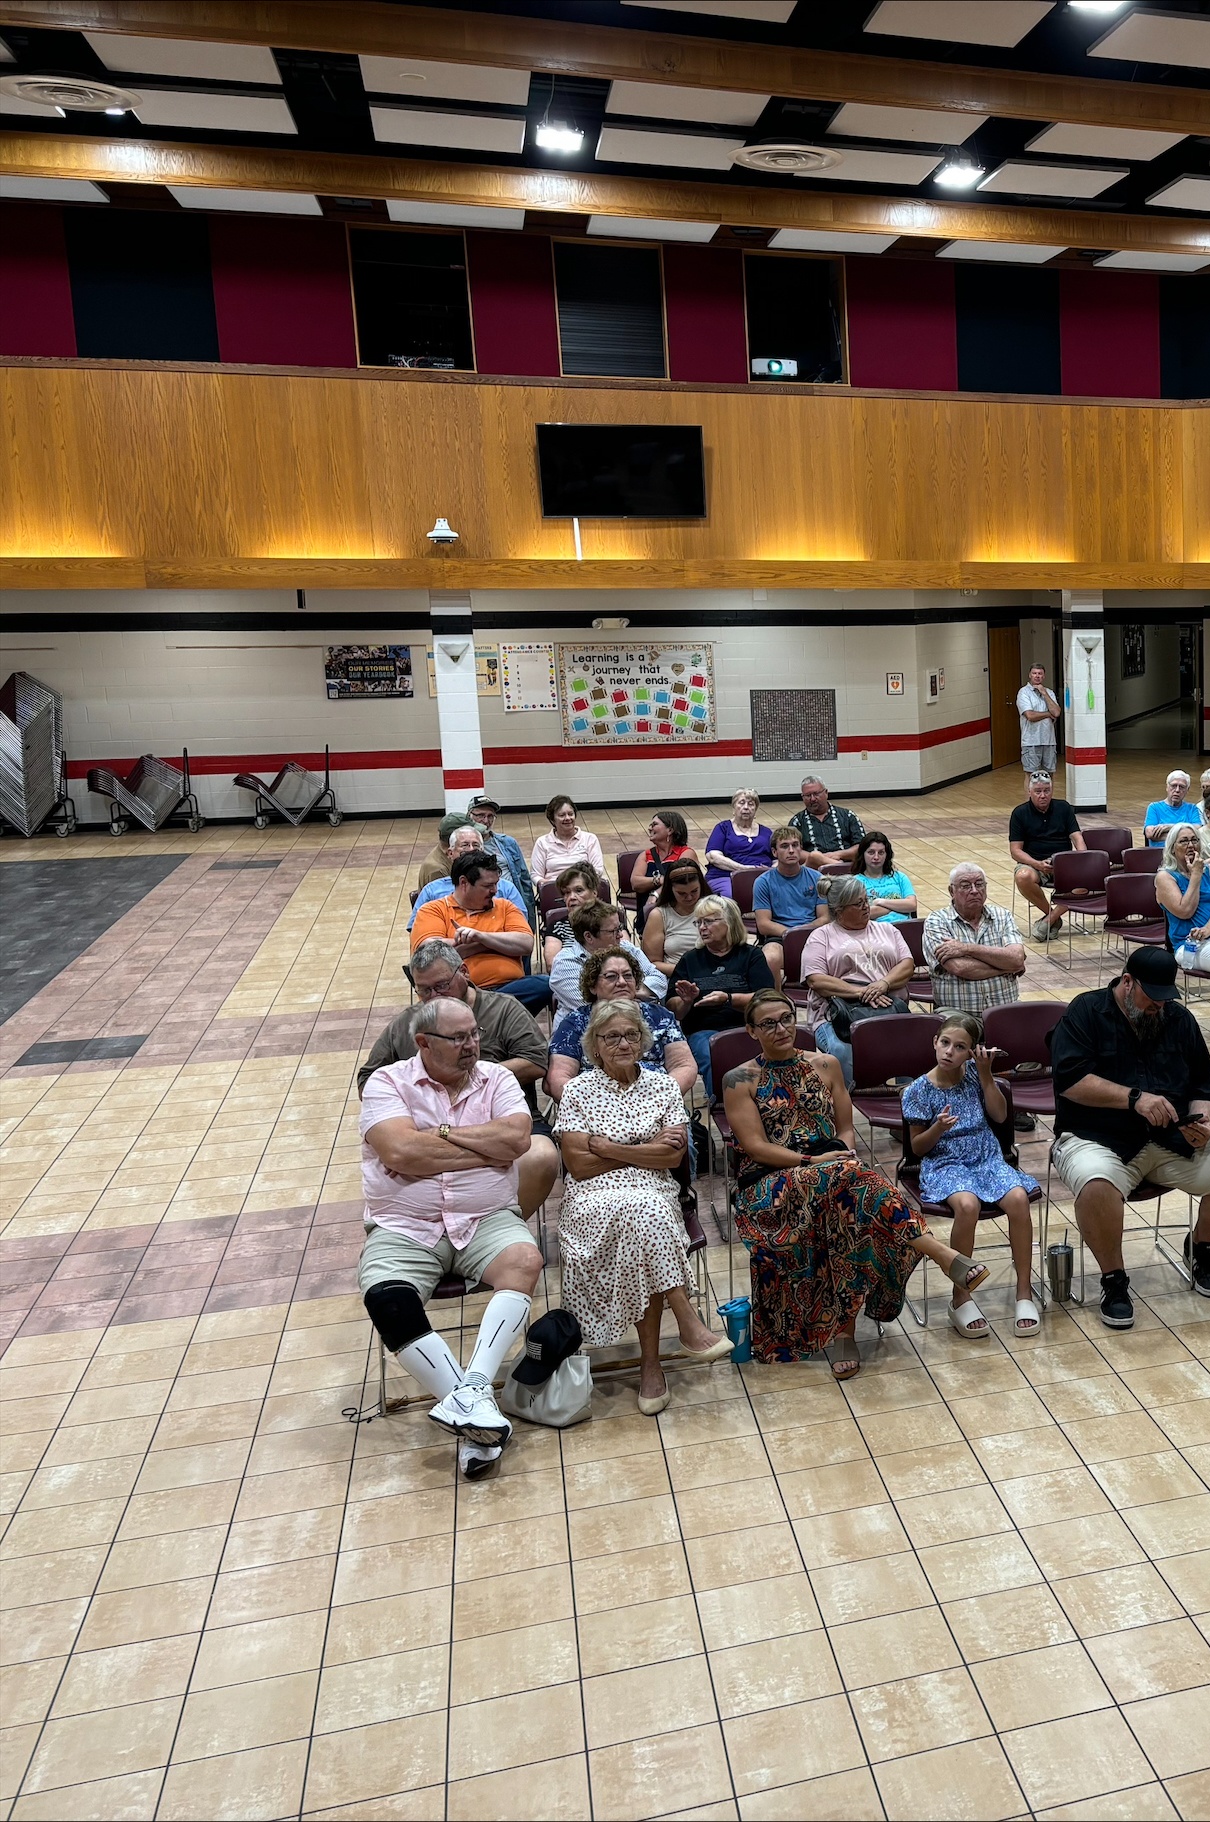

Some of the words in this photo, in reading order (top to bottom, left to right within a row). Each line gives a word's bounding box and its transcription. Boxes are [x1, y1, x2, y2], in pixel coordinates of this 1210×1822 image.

[572, 653, 620, 664] Learning
[626, 652, 635, 662] is
[638, 653, 645, 662] a
[591, 665, 631, 676] journey
[638, 664, 661, 674] that
[610, 676, 640, 685] never
[645, 676, 671, 685] ends.
